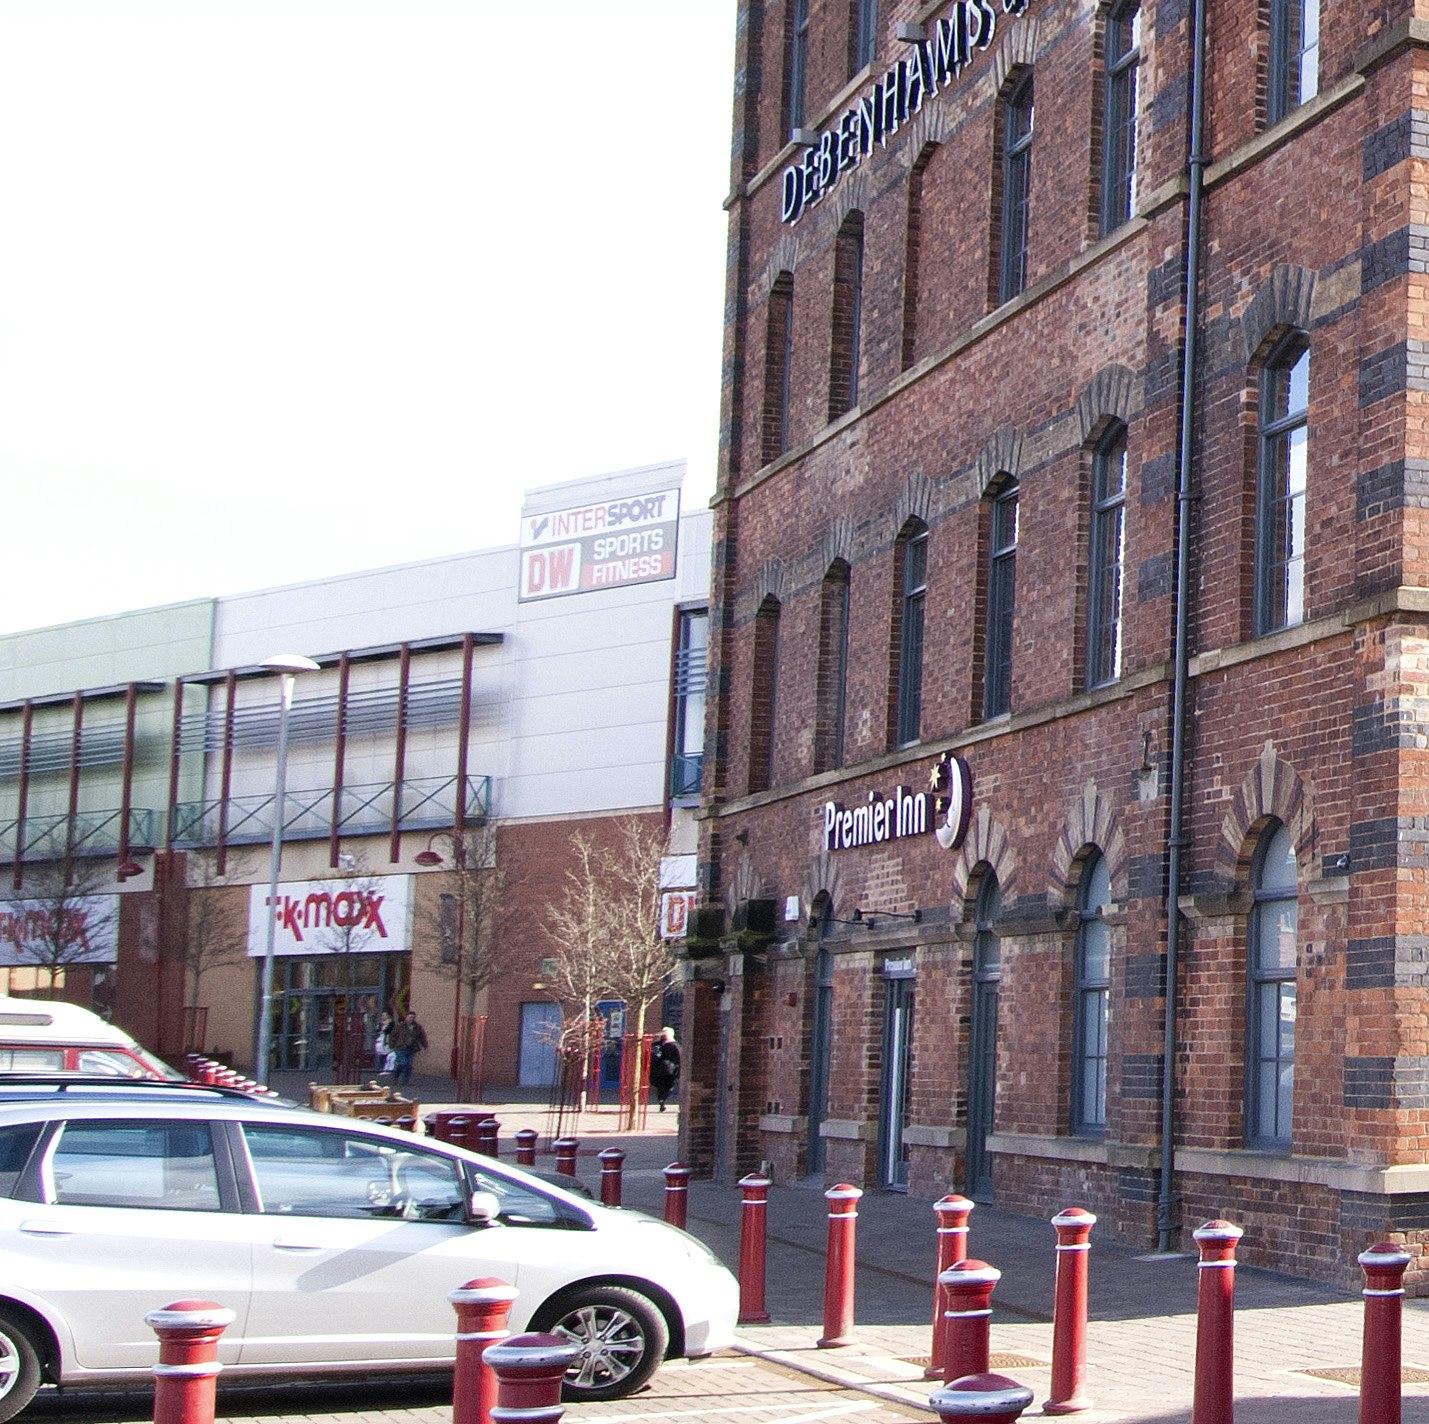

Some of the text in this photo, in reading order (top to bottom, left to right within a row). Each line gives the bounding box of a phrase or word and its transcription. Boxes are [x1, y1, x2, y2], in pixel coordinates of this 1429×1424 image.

[552, 495, 667, 537] INTERSPORT
[594, 528, 663, 560] SPORTS
[528, 547, 574, 593] DW
[592, 555, 662, 585] FITNESS
[825, 785, 927, 851] Premier Inn
[668, 896, 694, 932] D
